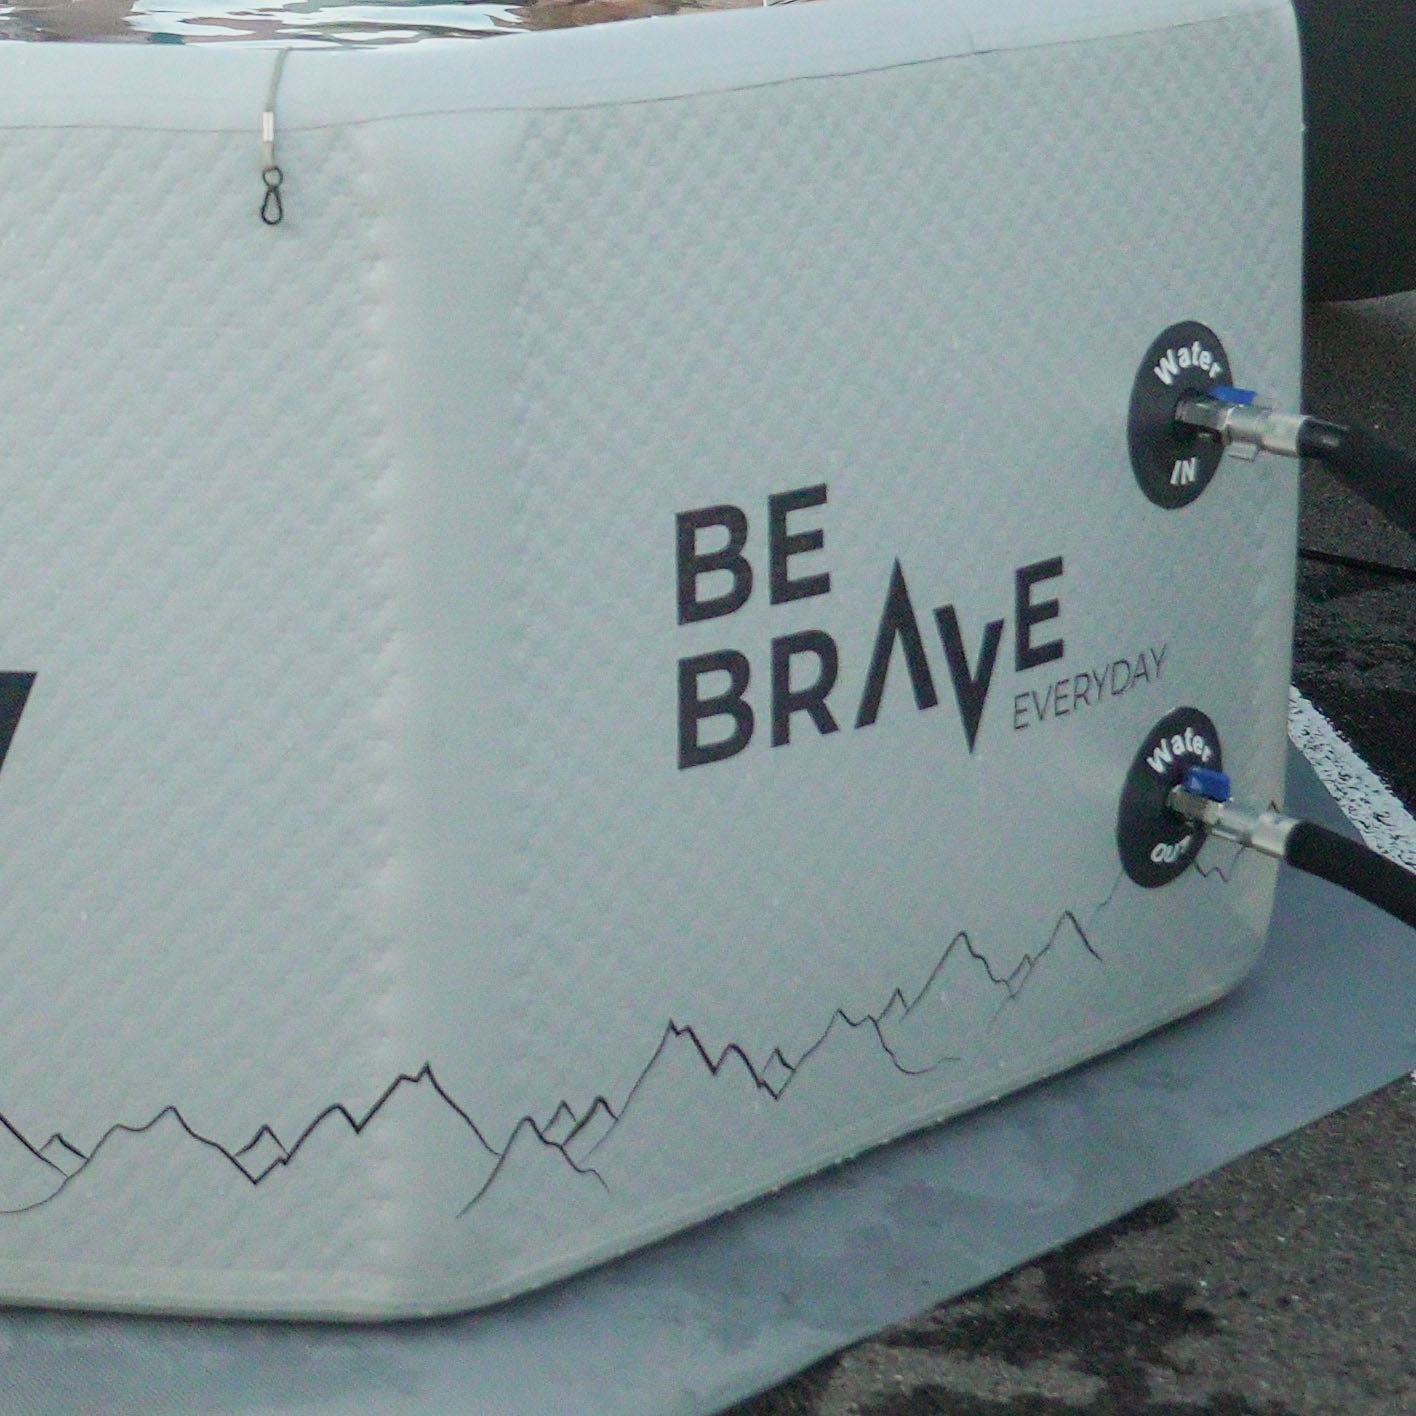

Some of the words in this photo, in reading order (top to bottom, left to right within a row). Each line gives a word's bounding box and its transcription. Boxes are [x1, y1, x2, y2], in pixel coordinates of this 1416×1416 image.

[1154, 341, 1224, 385] Water
[1170, 457, 1197, 485] IN
[675, 482, 832, 626] BE
[677, 555, 1065, 770] BRAVE
[1012, 643, 1168, 731] EVERYDAY
[1146, 727, 1212, 774] Water
